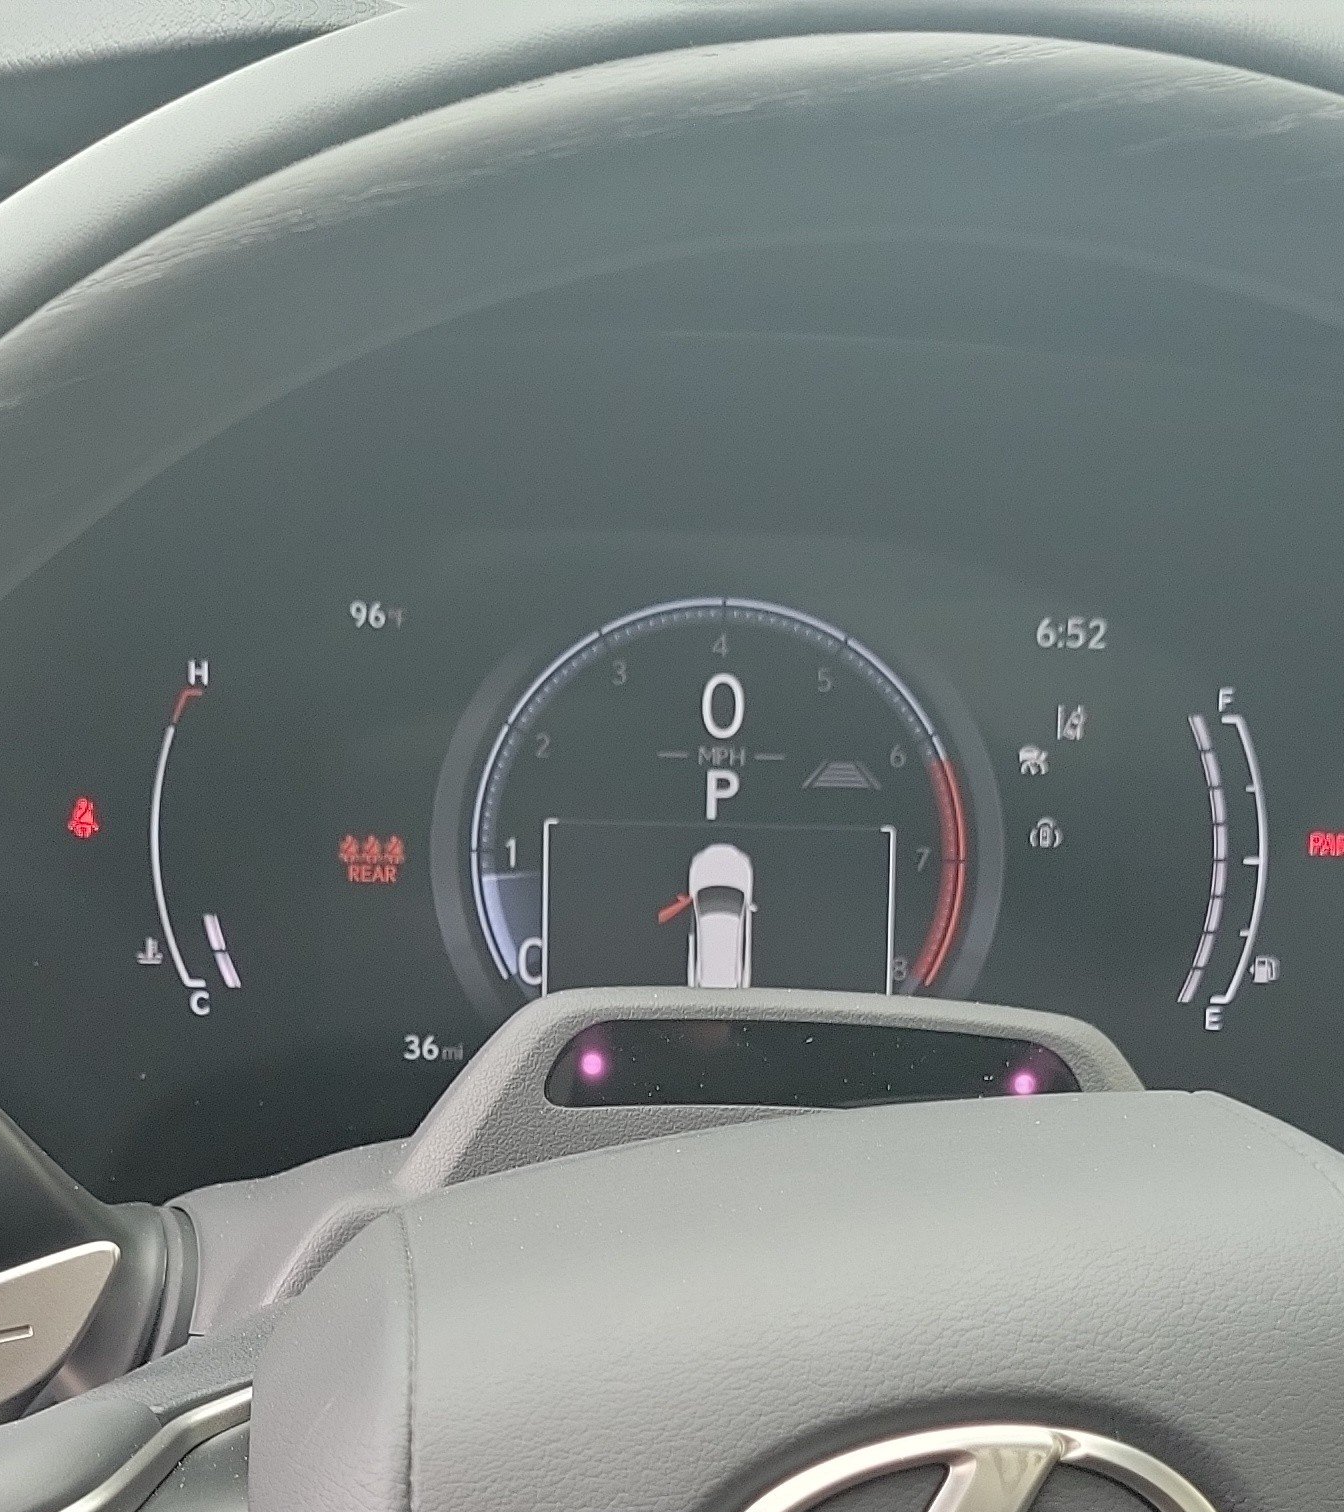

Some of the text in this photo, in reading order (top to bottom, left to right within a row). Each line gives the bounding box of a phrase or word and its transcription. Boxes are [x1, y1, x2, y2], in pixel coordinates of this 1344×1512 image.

[1036, 616, 1106, 649] 6:52
[188, 660, 208, 686] H
[701, 672, 745, 739] 0
[1218, 687, 1235, 712] F
[698, 746, 746, 767] MPH
[706, 768, 740, 821] P
[506, 838, 517, 868] 1
[348, 866, 397, 882] REAR
[190, 990, 210, 1015] C
[1205, 1006, 1223, 1031] E
